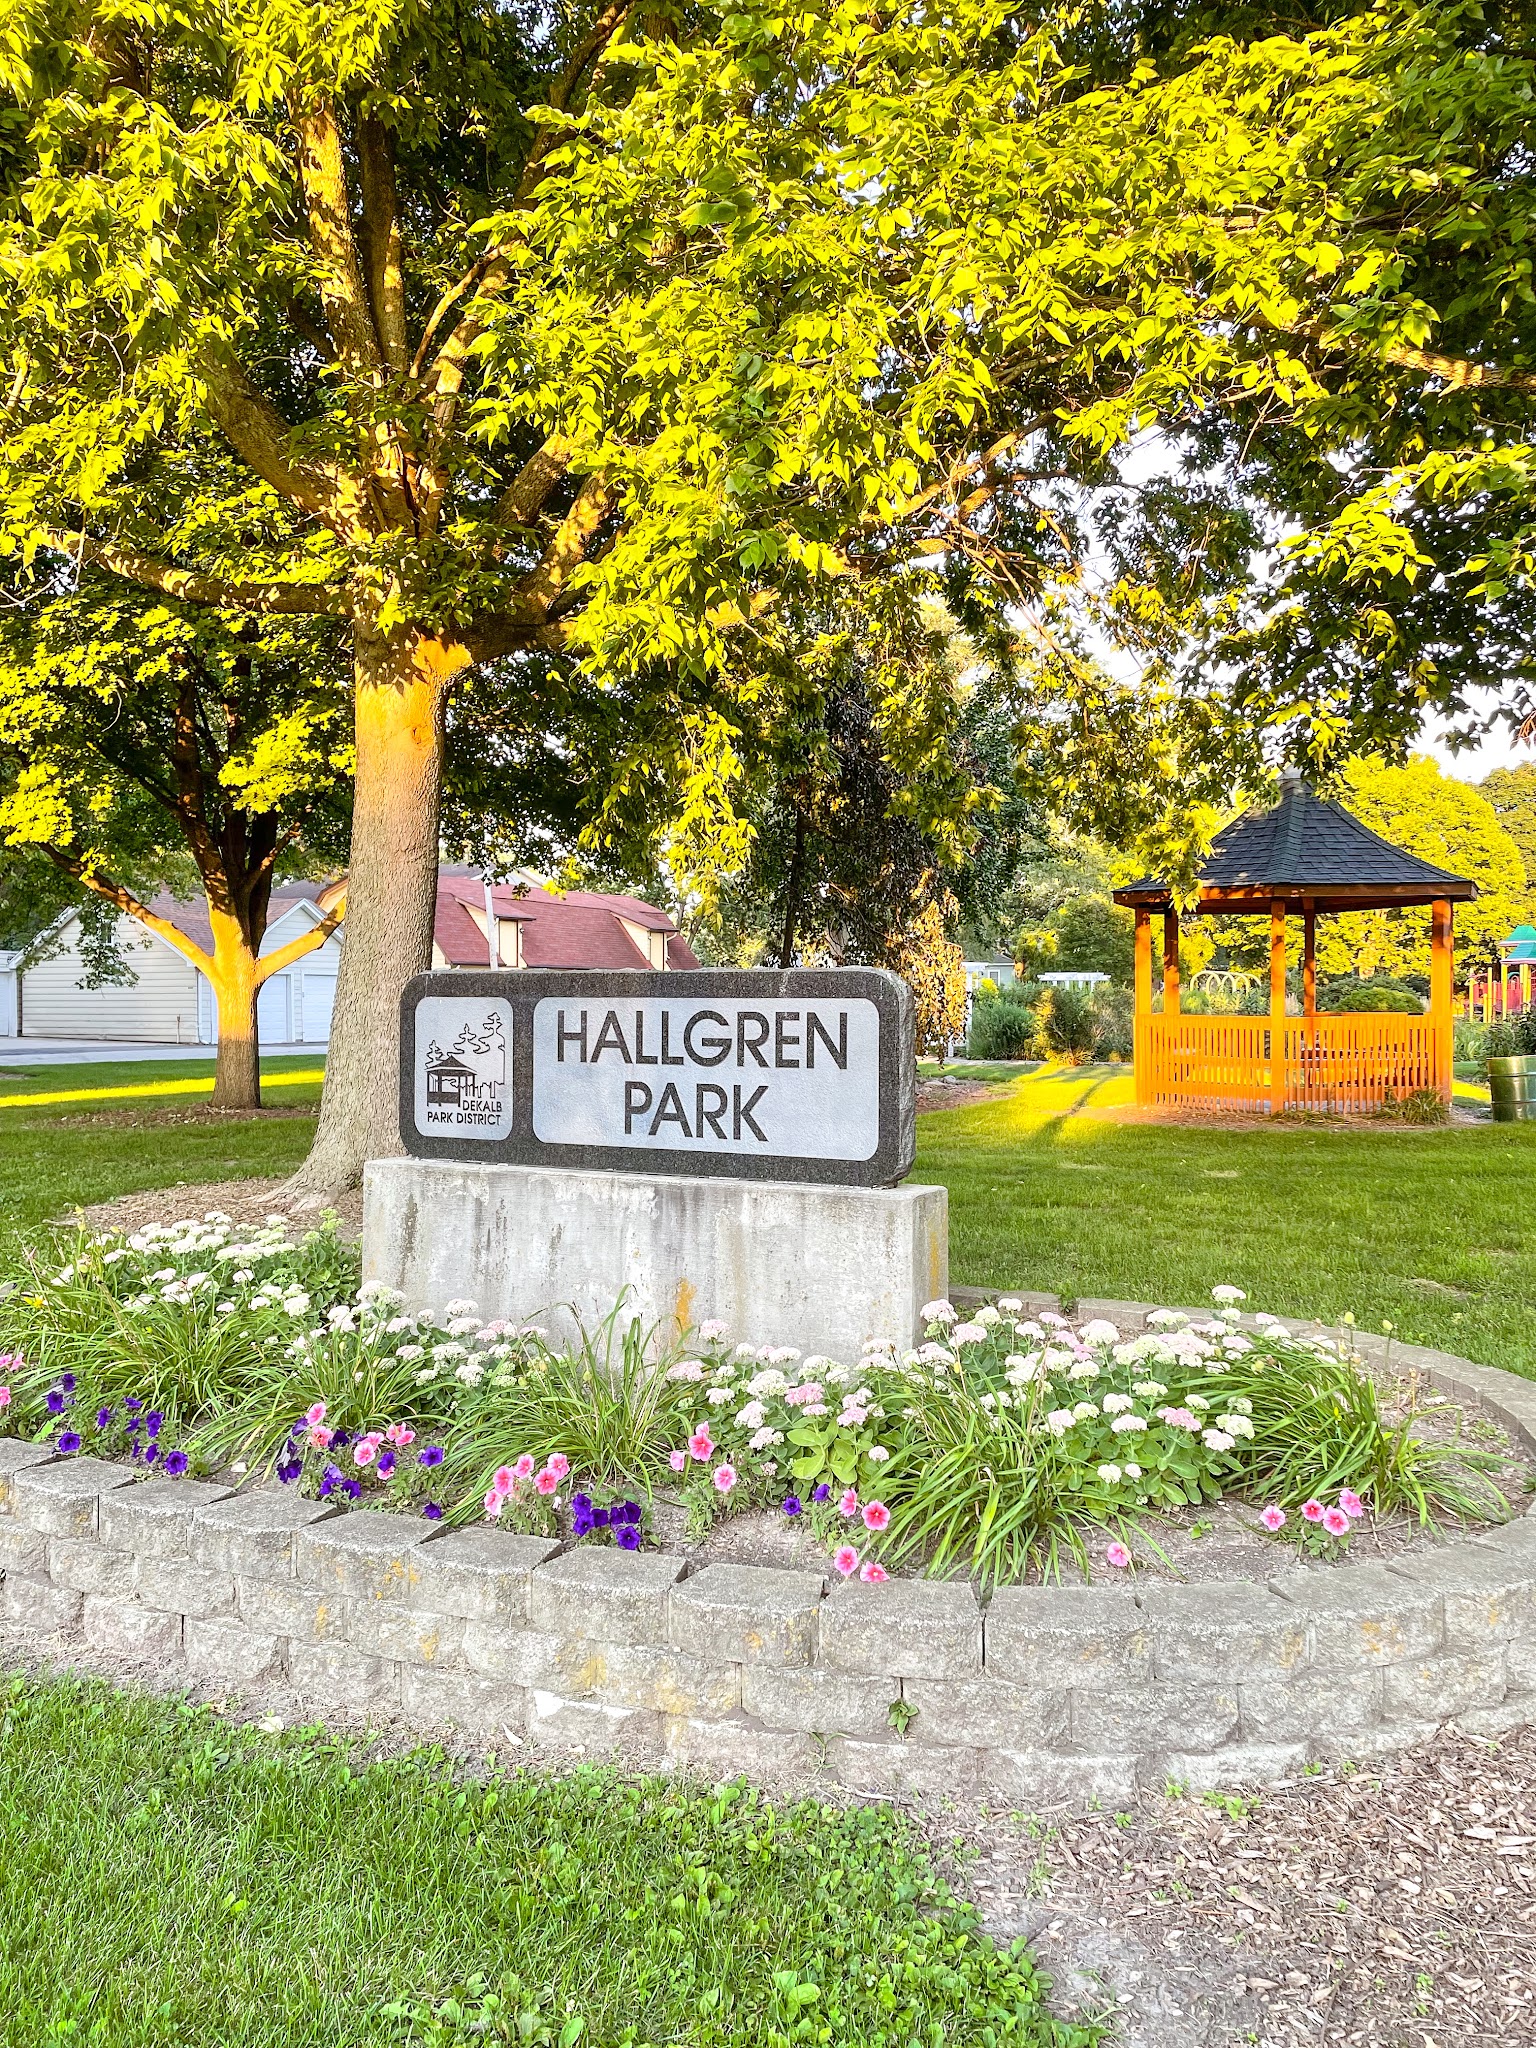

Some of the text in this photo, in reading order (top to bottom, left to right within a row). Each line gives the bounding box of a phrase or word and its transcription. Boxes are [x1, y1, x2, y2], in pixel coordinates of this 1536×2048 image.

[556, 1010, 848, 1070] HALLGREN
[427, 1112, 501, 1125] PARK DISTRICT
[462, 1100, 502, 1112] DEKALB
[624, 1081, 769, 1142] PARK
